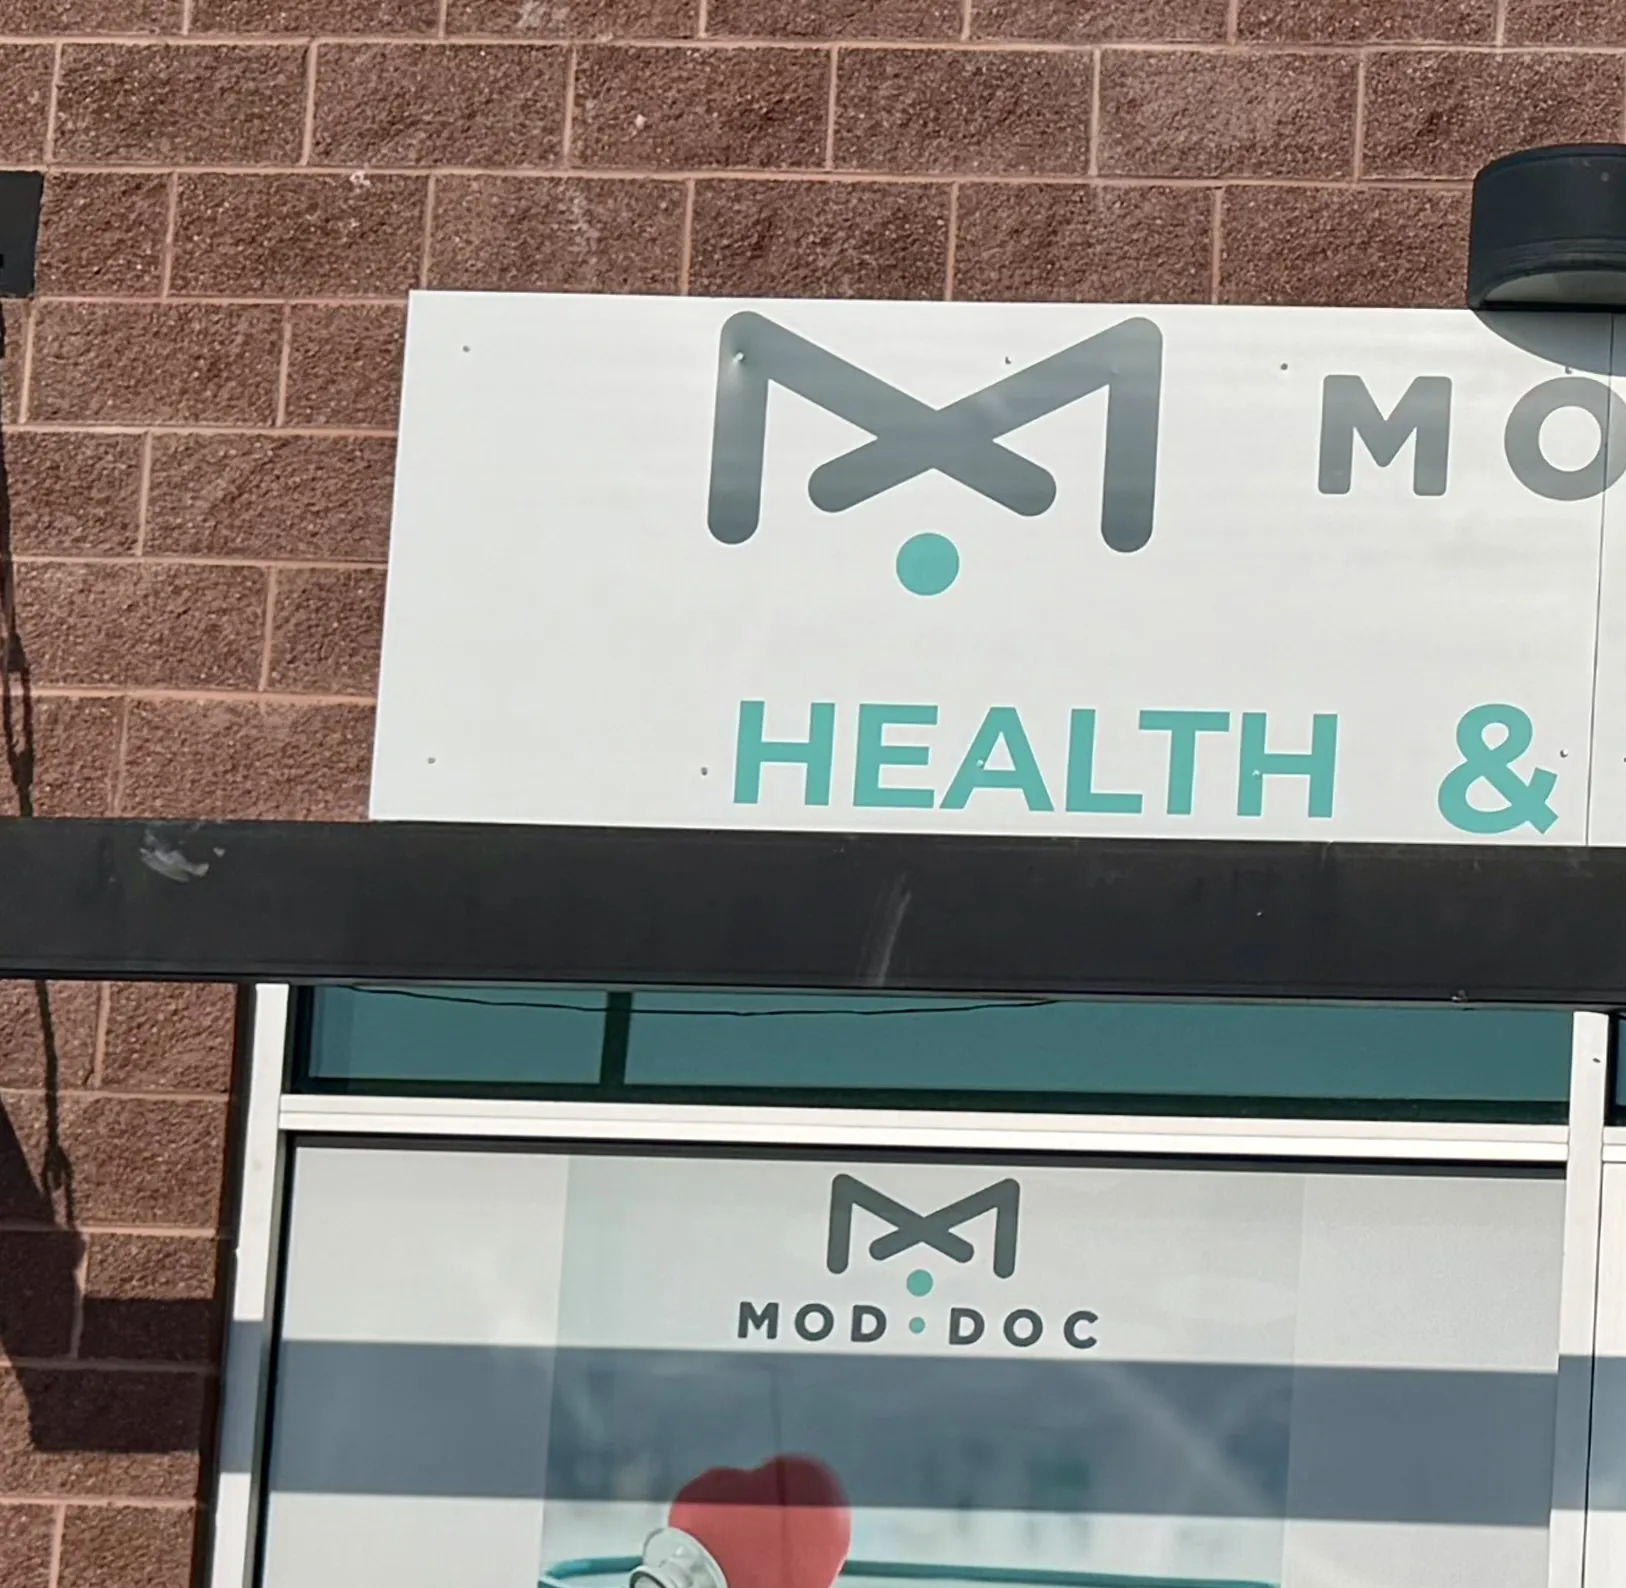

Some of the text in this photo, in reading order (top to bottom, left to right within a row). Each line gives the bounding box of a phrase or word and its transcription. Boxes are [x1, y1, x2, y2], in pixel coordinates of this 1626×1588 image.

[732, 700, 1338, 818] HEALTH
[1438, 703, 1560, 834] &
[738, 1301, 1099, 1349] MOD DOC
